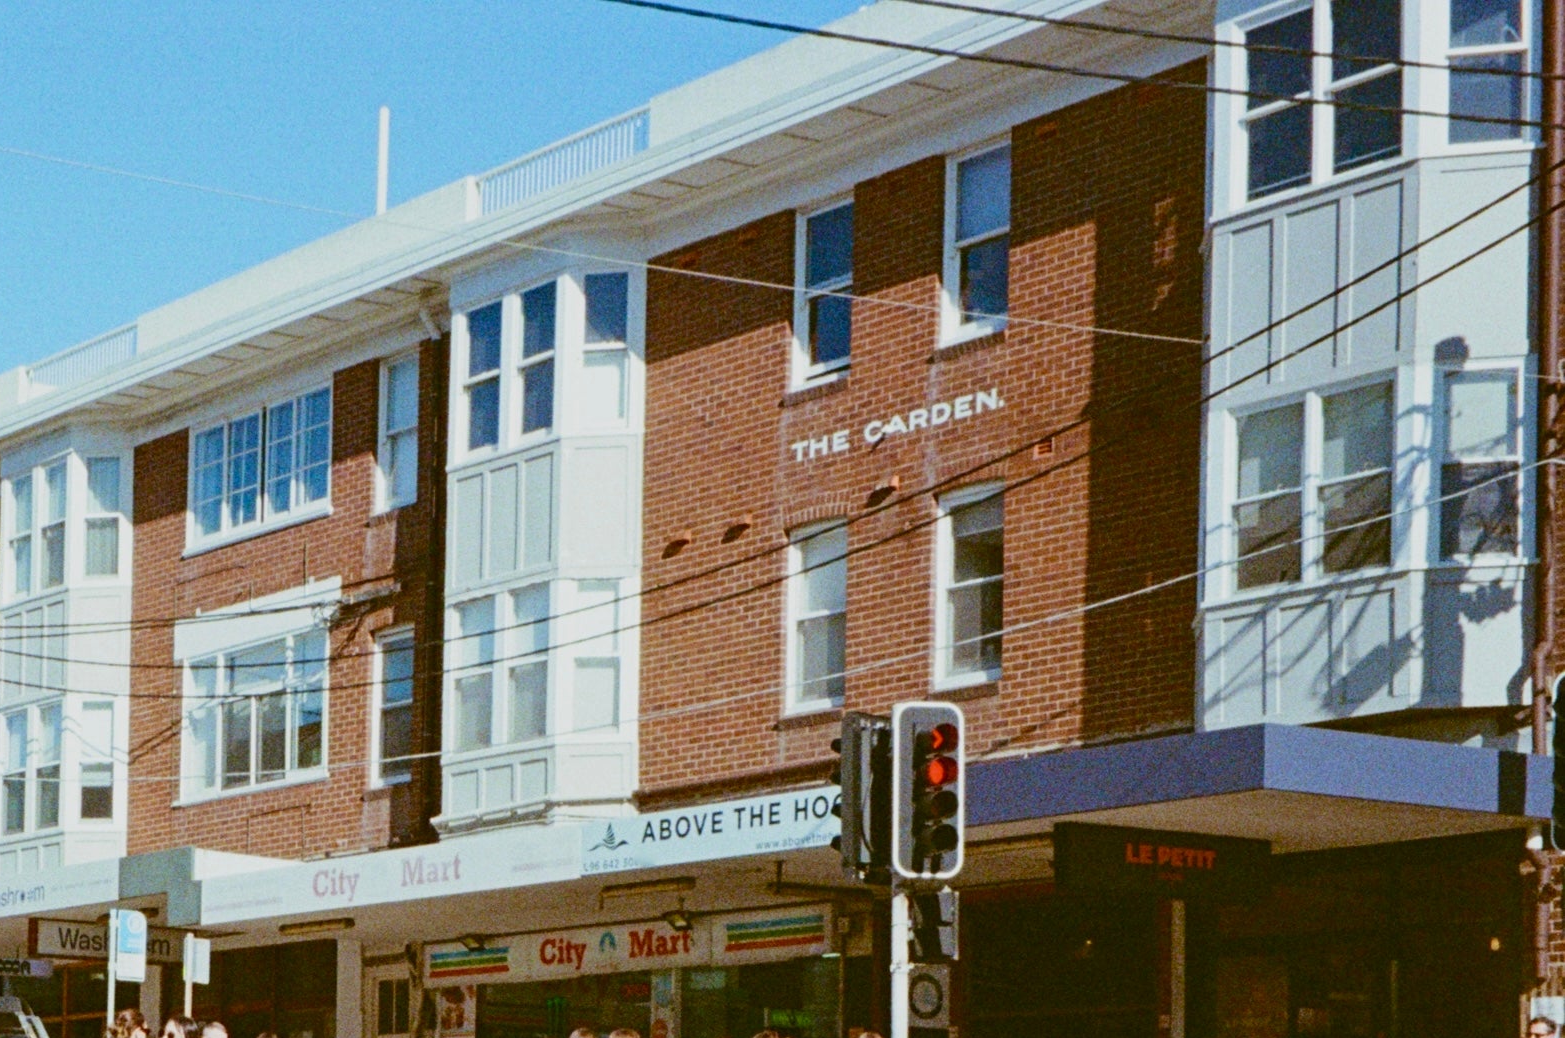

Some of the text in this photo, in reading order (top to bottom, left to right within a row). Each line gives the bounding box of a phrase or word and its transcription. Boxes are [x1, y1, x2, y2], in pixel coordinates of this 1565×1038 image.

[791, 429, 850, 462] THE
[642, 811, 723, 844] ABOVE
[734, 802, 781, 829] THE
[312, 853, 462, 901] City Mart
[1124, 842, 1217, 870] LE PETIT
[539, 927, 691, 970] City Mart
